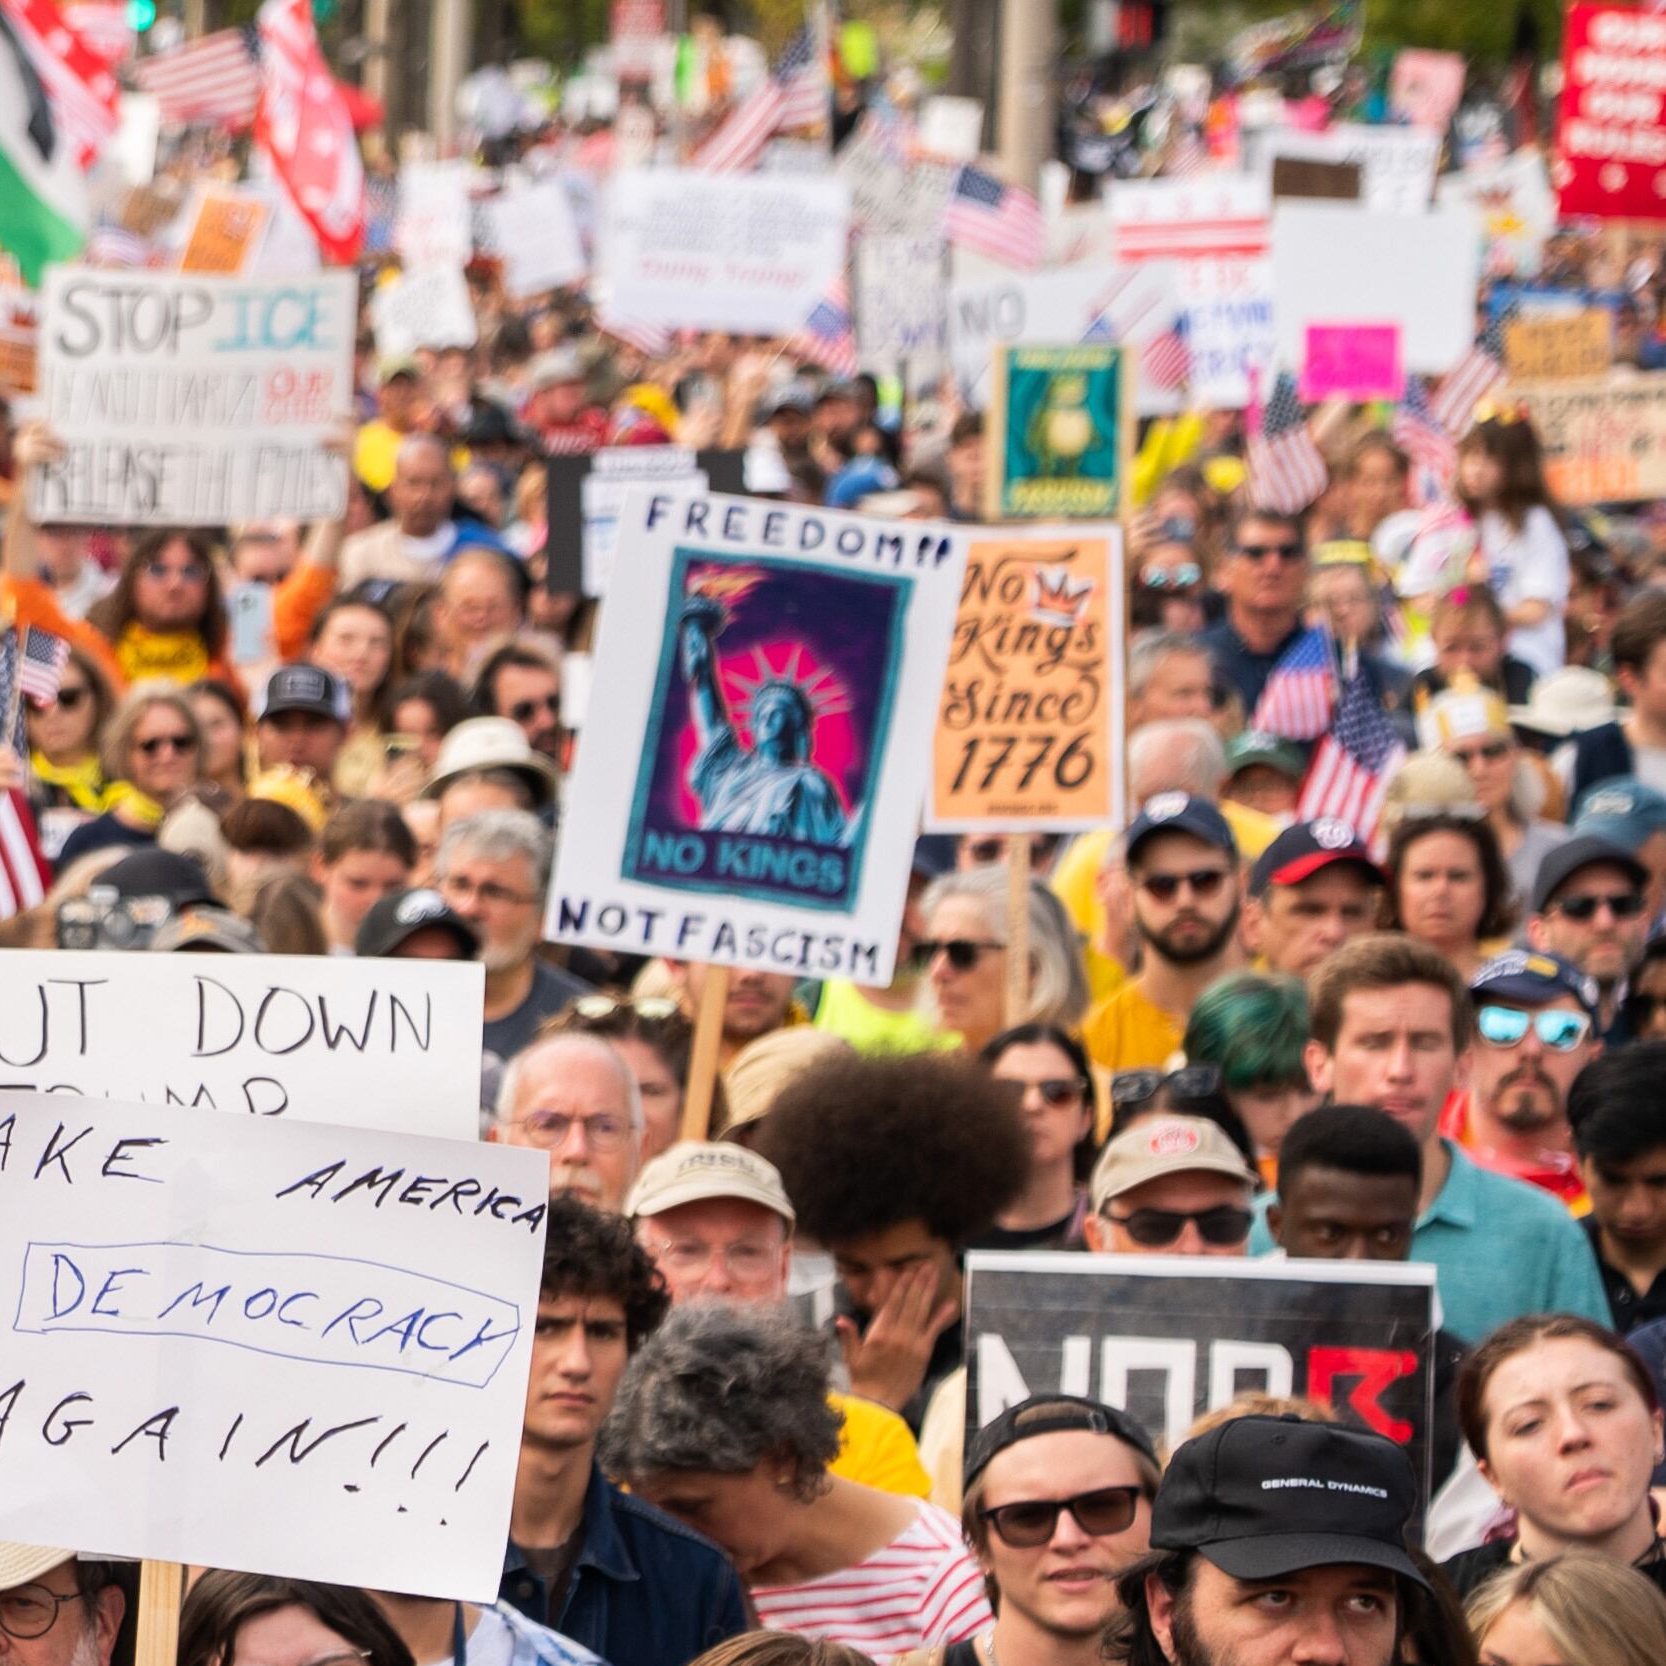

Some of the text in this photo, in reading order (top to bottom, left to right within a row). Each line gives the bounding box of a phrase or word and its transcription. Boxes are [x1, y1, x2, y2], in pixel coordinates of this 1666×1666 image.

[55, 278, 337, 359] STOP ICE
[947, 612, 1103, 675] Kings
[941, 671, 1100, 732] Since
[949, 730, 1095, 796] 1776
[642, 828, 848, 893] NO KINGS
[558, 893, 880, 978] NOT FASCISM
[192, 975, 433, 1058] DOWN
[43, 1252, 520, 1363] DEMOCRACY
[1261, 1477, 1389, 1499] GENERAL DYNAMICS
